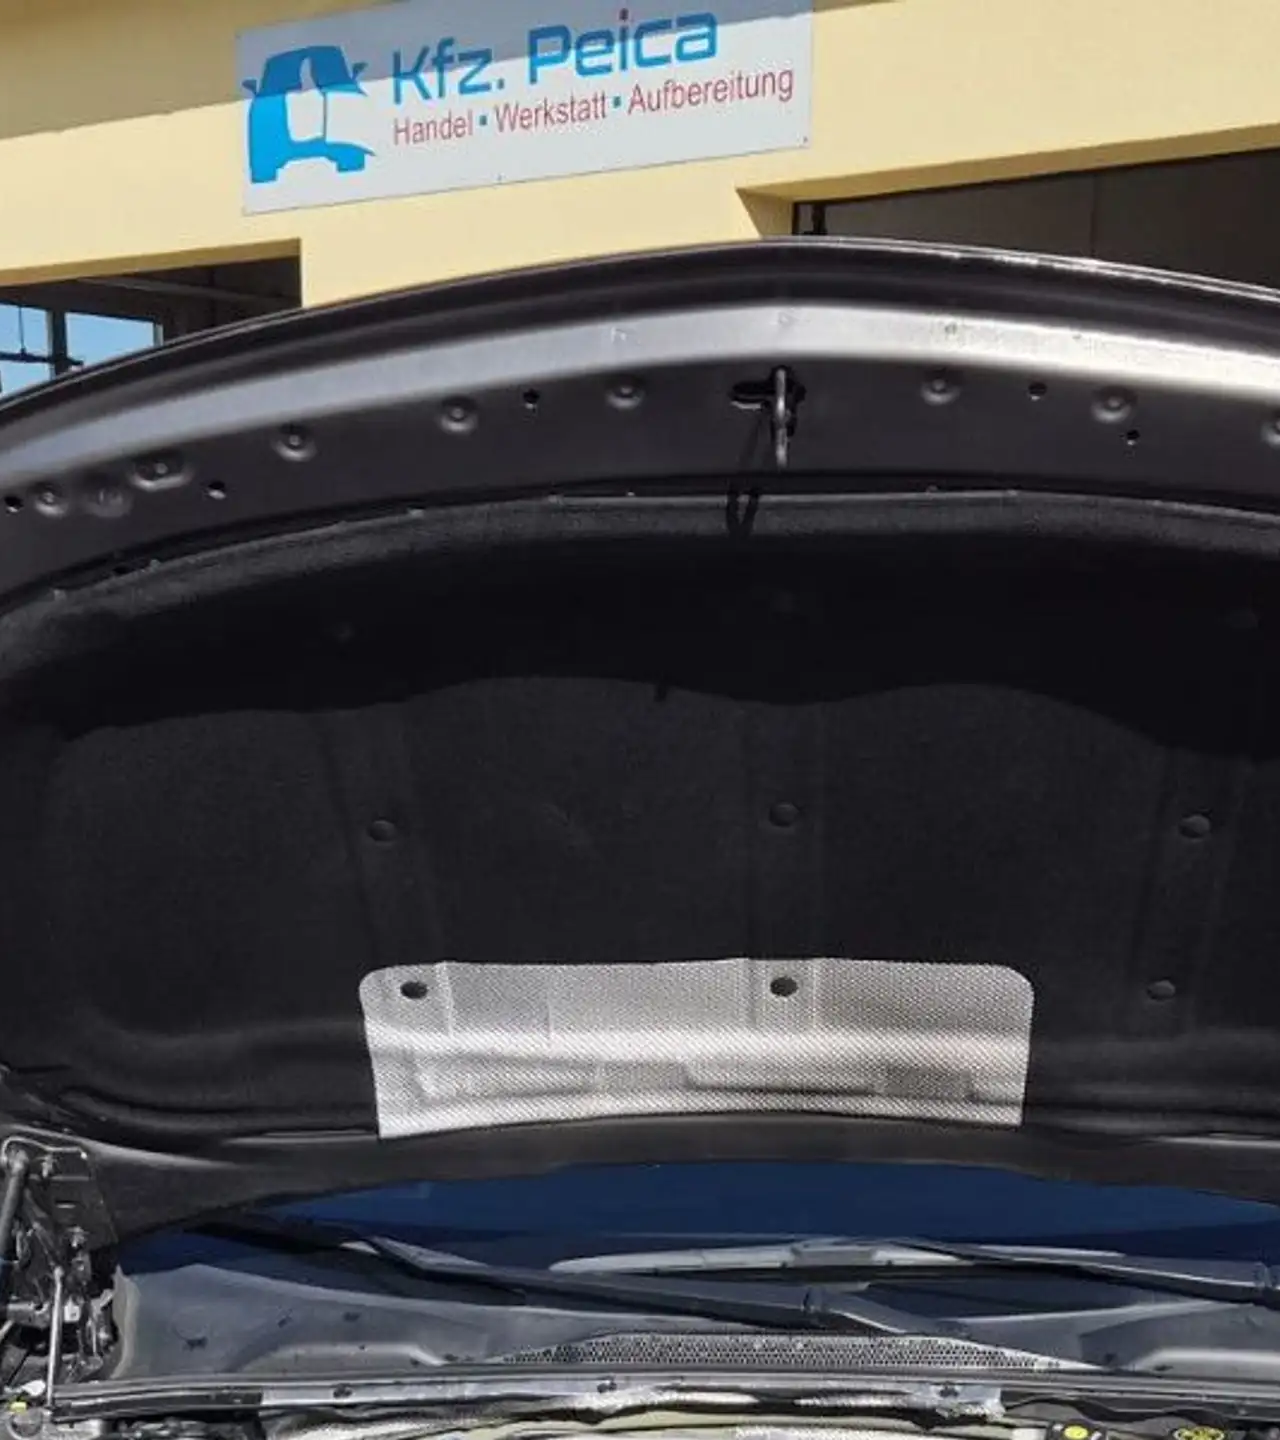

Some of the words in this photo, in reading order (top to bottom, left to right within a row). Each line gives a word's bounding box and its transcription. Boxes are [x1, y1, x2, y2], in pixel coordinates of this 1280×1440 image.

[392, 36, 505, 105] Kfz.
[529, 8, 718, 84] Peica
[393, 111, 475, 147] Handel
[494, 94, 608, 134] Werkstatt
[627, 66, 795, 115] Aufbereitung
